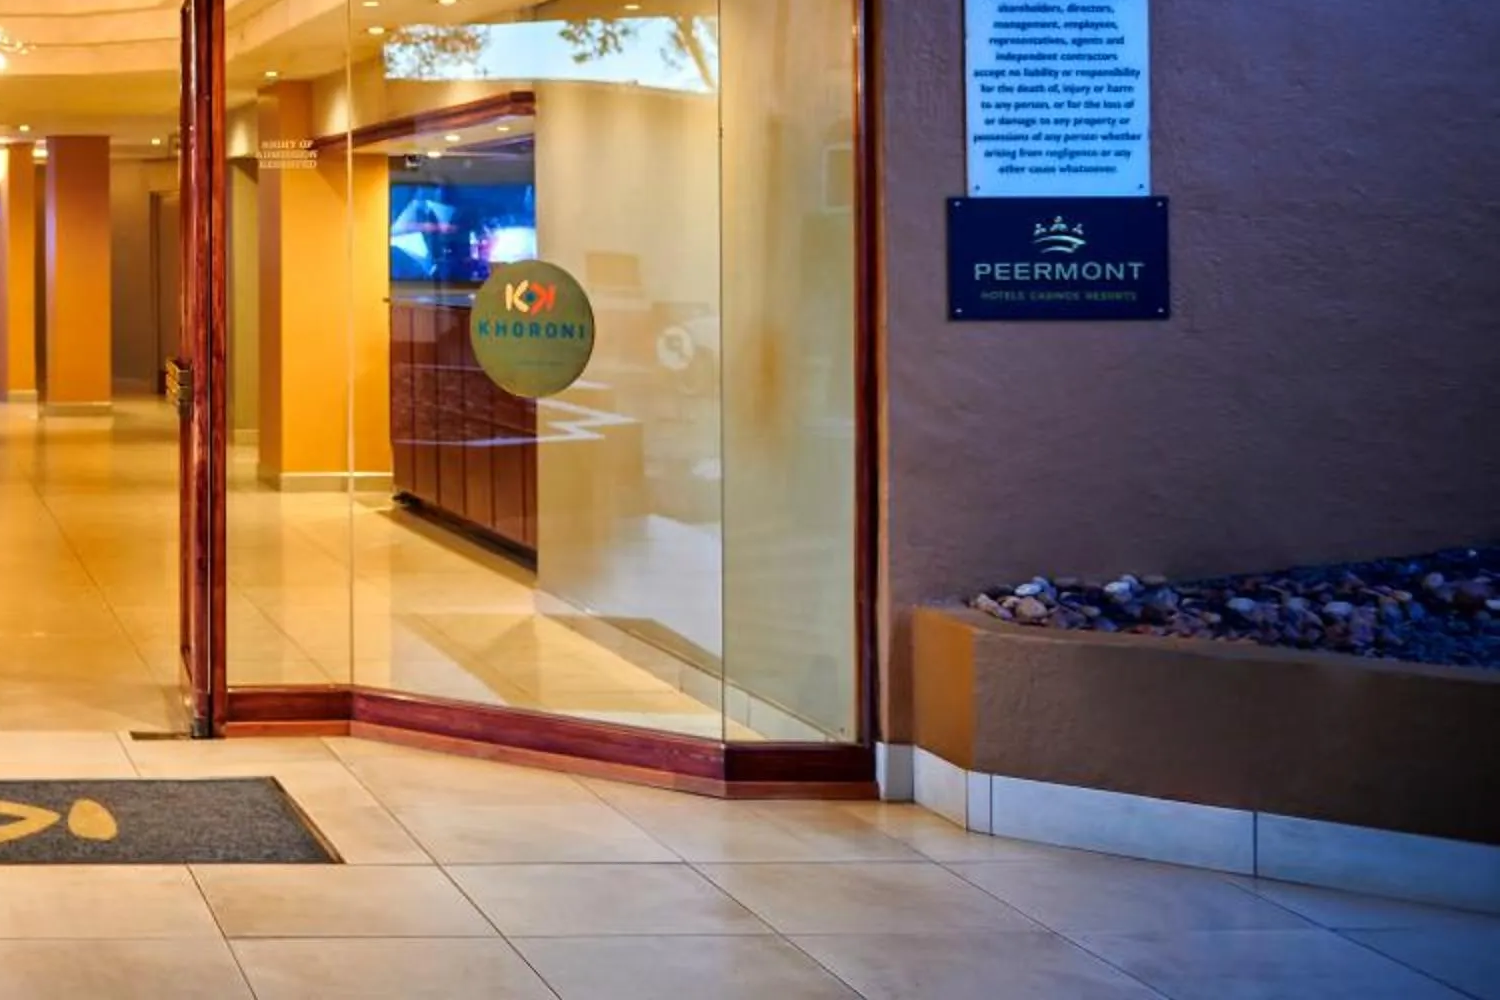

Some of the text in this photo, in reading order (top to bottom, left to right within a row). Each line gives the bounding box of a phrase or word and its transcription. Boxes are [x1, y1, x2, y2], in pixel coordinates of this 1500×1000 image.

[299, 140, 314, 148] OF
[974, 262, 1144, 280] PEERMONT
[981, 291, 1025, 300] HOTELS
[1085, 291, 1136, 300] RESORTS
[479, 320, 585, 338] KHORONI
